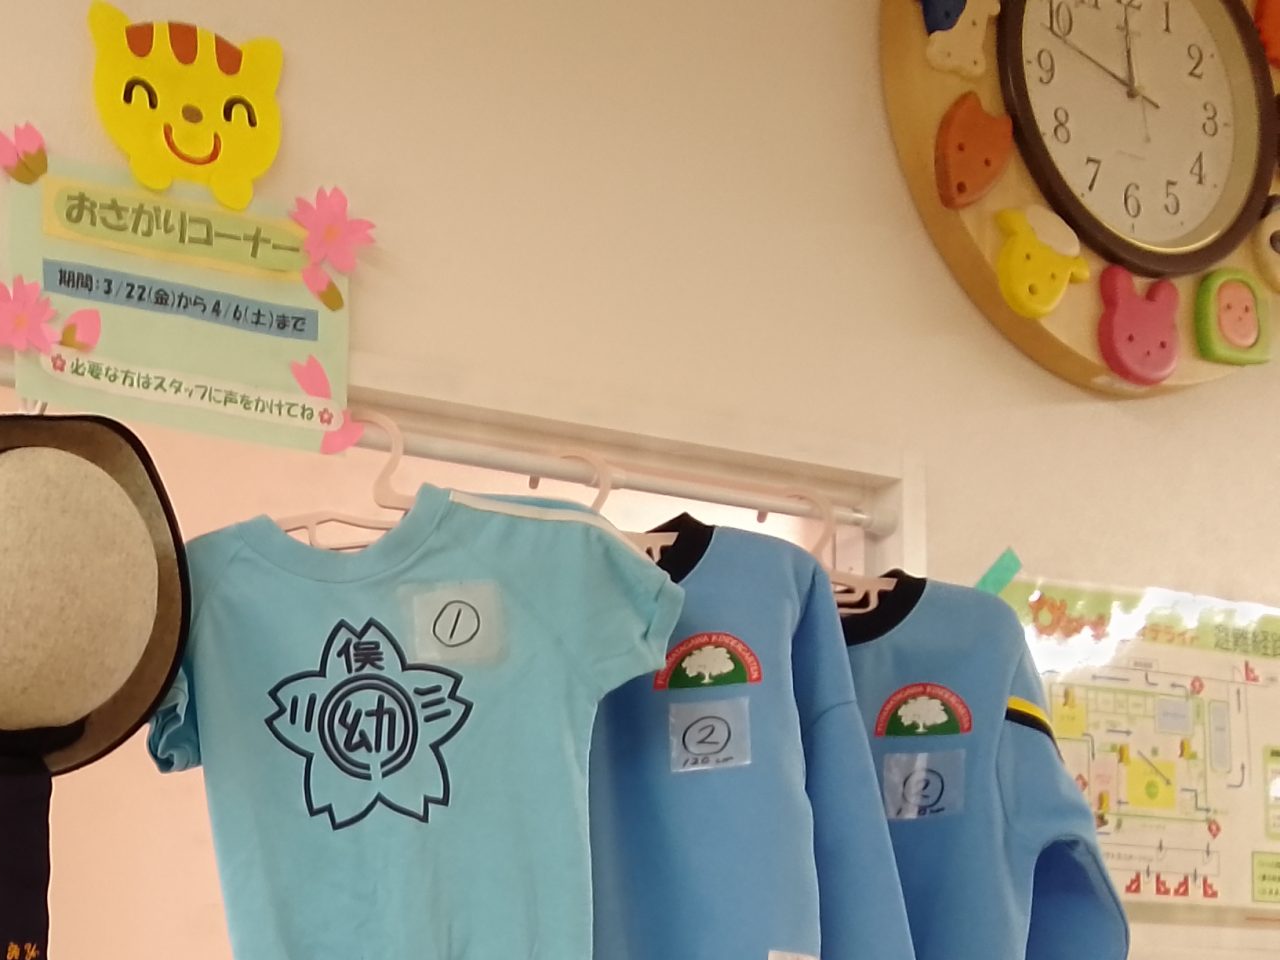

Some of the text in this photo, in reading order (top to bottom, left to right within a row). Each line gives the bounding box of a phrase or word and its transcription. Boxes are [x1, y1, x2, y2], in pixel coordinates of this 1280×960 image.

[1038, 48, 1056, 84] 9
[1187, 43, 1204, 79] 2
[1053, 107, 1071, 144] 8
[1202, 102, 1219, 137] 3
[1085, 157, 1101, 192] 7
[1190, 152, 1205, 186] 4
[1123, 182, 1141, 218] 6
[1164, 180, 1180, 215] 5
[65, 191, 301, 258] おさがりコーナー
[70, 360, 315, 420] 必要な方はスタッフに声をかけてね
